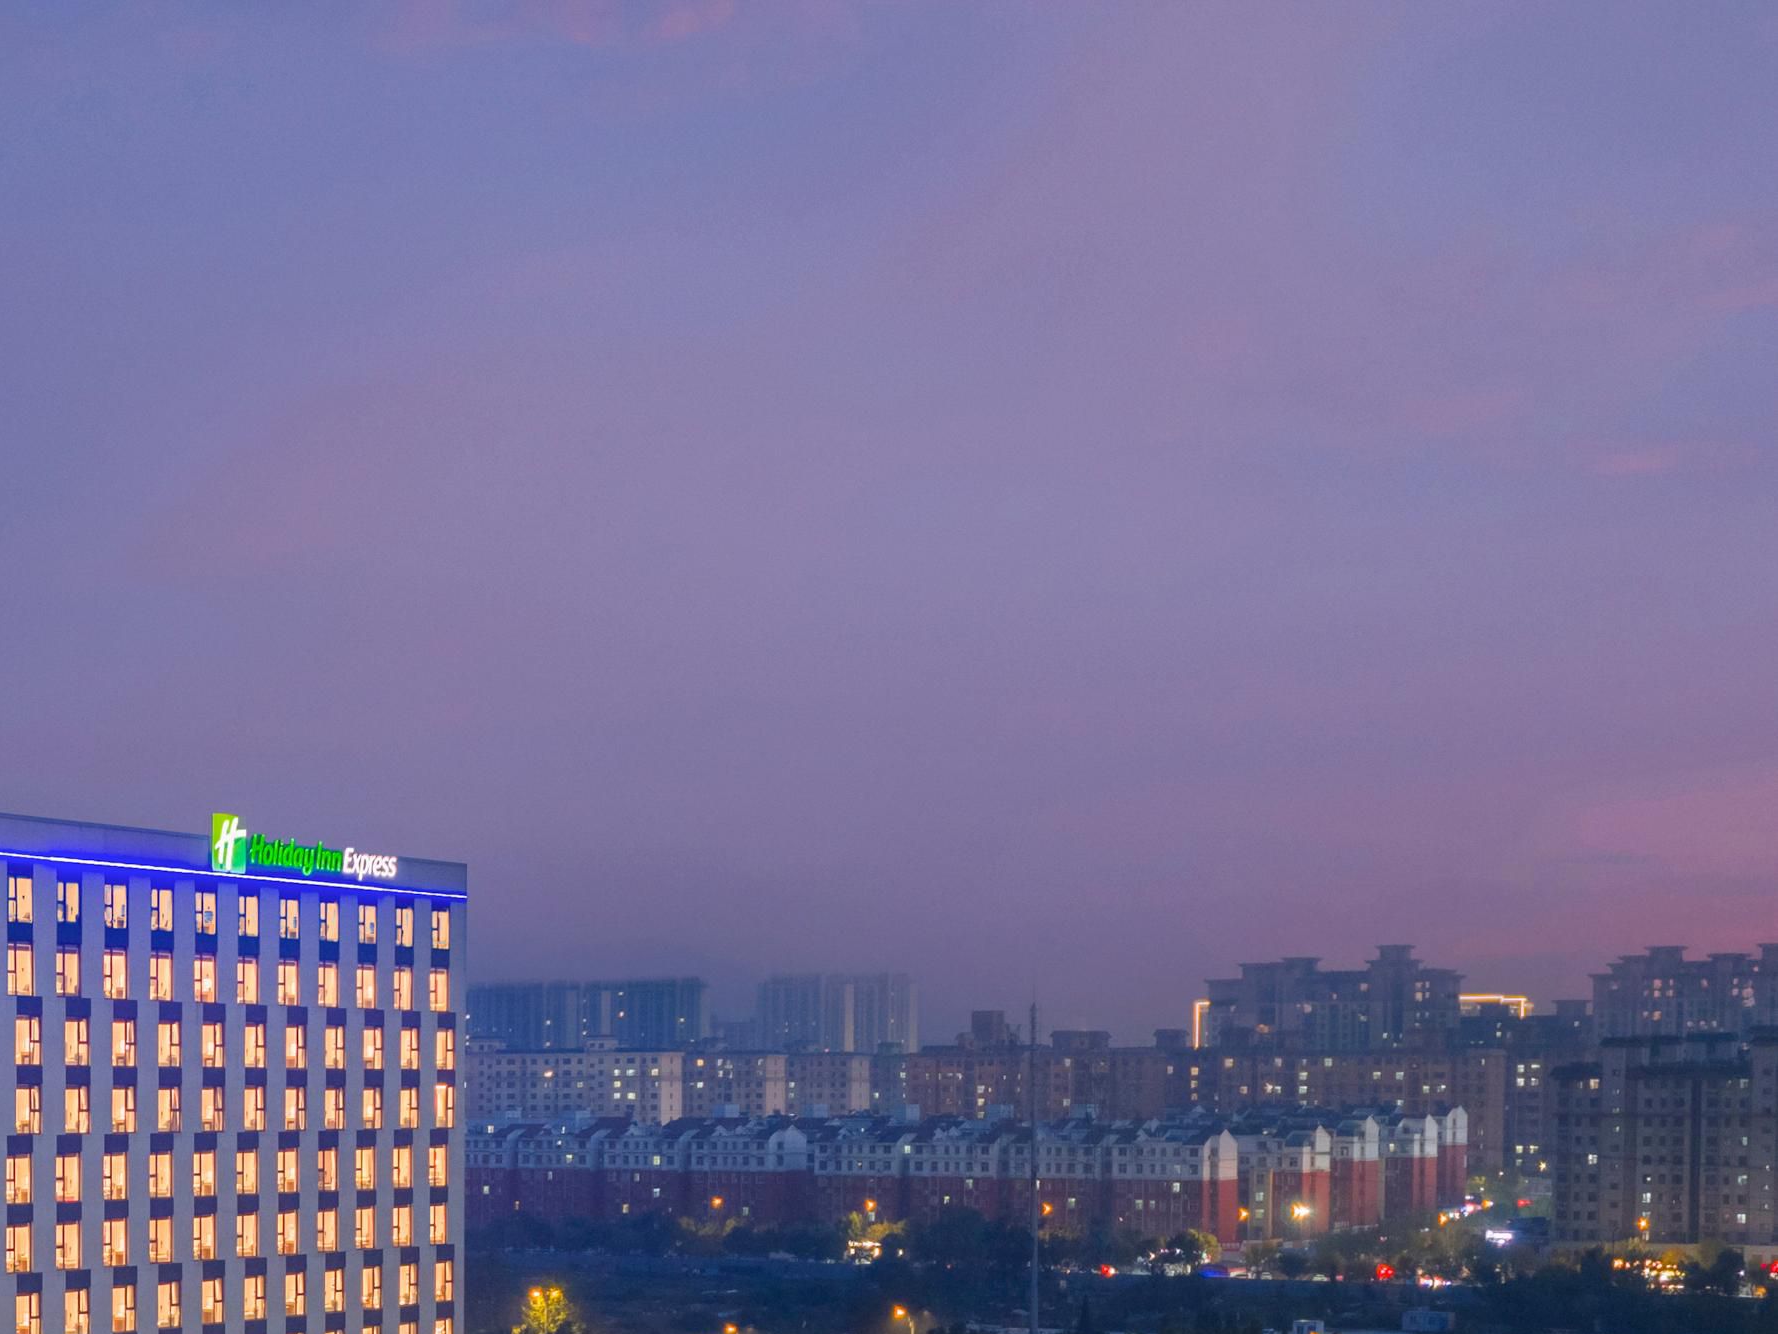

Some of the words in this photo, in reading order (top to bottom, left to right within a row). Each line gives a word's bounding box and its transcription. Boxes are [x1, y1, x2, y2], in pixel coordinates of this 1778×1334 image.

[249, 833, 315, 876] Holiday
[316, 841, 342, 872] Inn
[342, 847, 397, 881] Express
